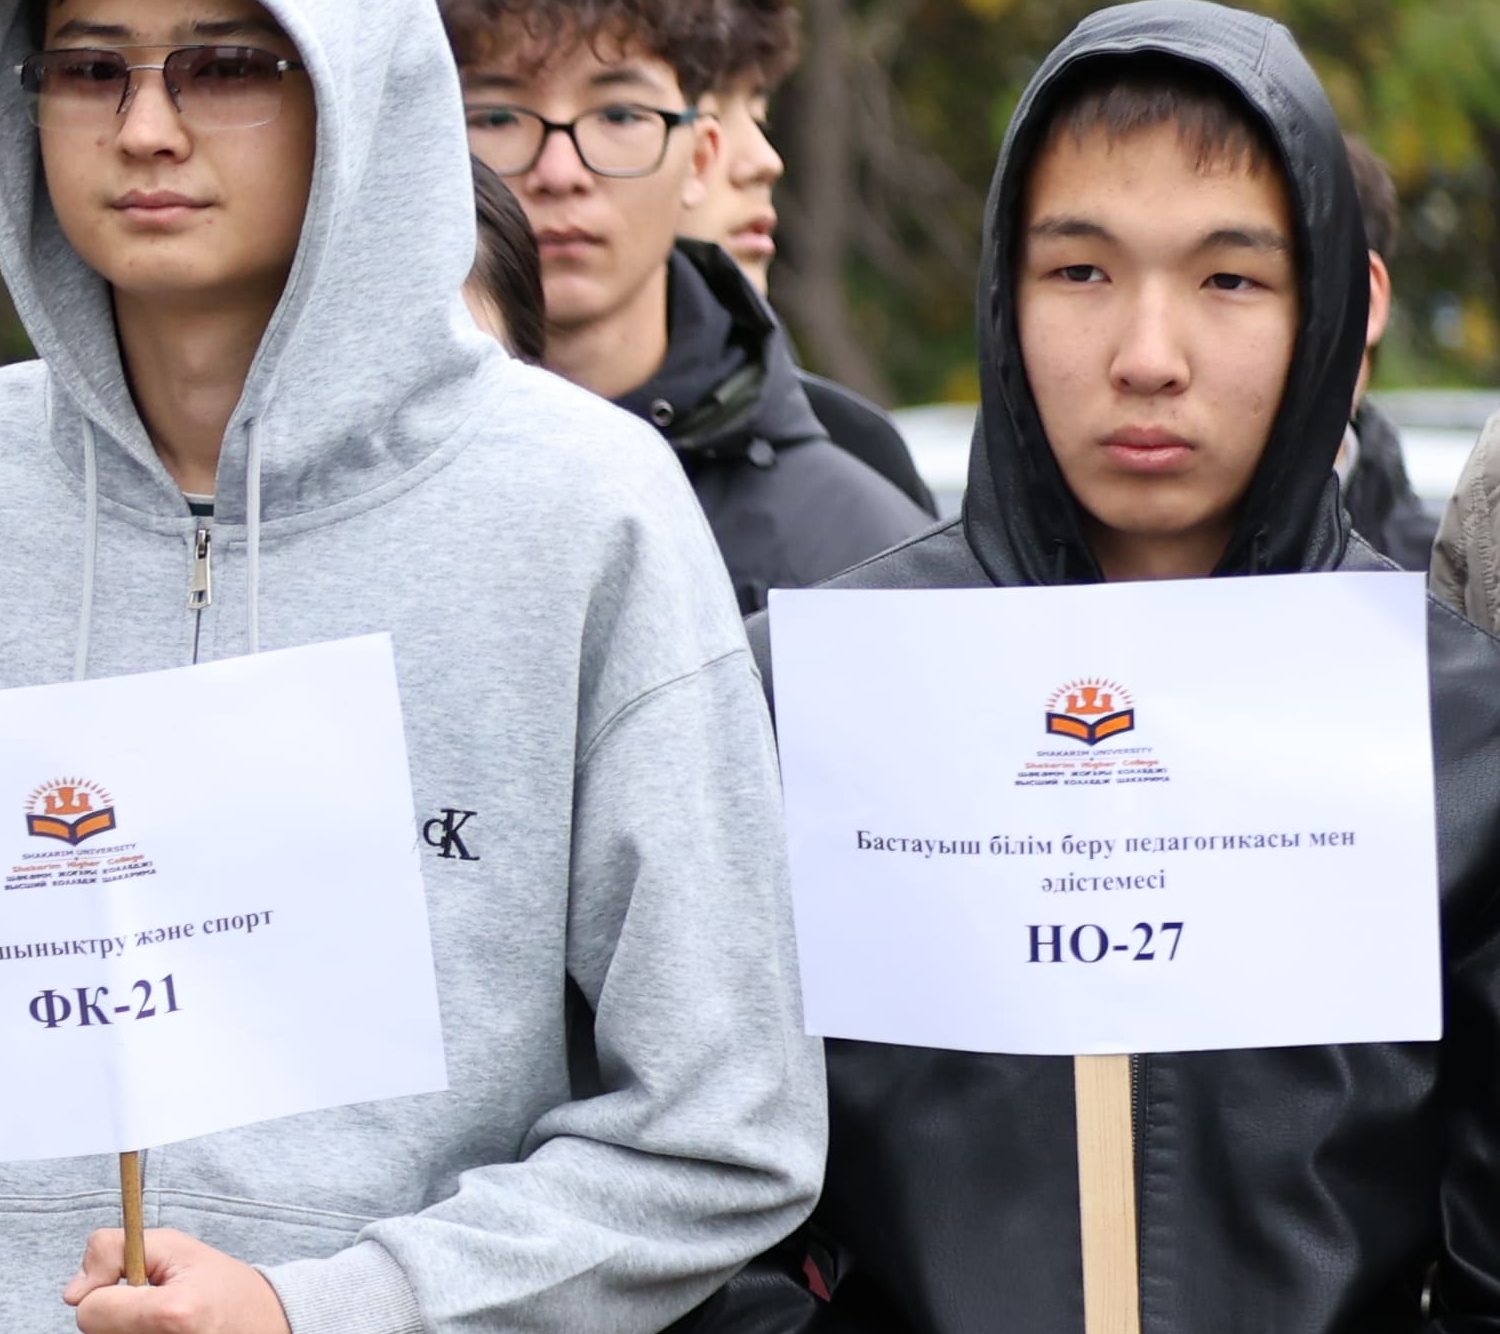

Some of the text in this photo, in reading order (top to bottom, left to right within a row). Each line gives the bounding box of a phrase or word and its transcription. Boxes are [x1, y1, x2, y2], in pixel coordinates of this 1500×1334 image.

[1092, 747, 1153, 756] UNIVERSITY
[22, 843, 137, 860] SHAKARIM UNIVERSITY
[855, 829, 1357, 860] Бастауыш білім беру педагогикасы мен
[1041, 869, 1166, 895] әдістемесі
[134, 923, 195, 947] және
[202, 909, 275, 934] спорт
[1025, 921, 1186, 964] НО-27
[28, 973, 184, 1029] ФК-21
